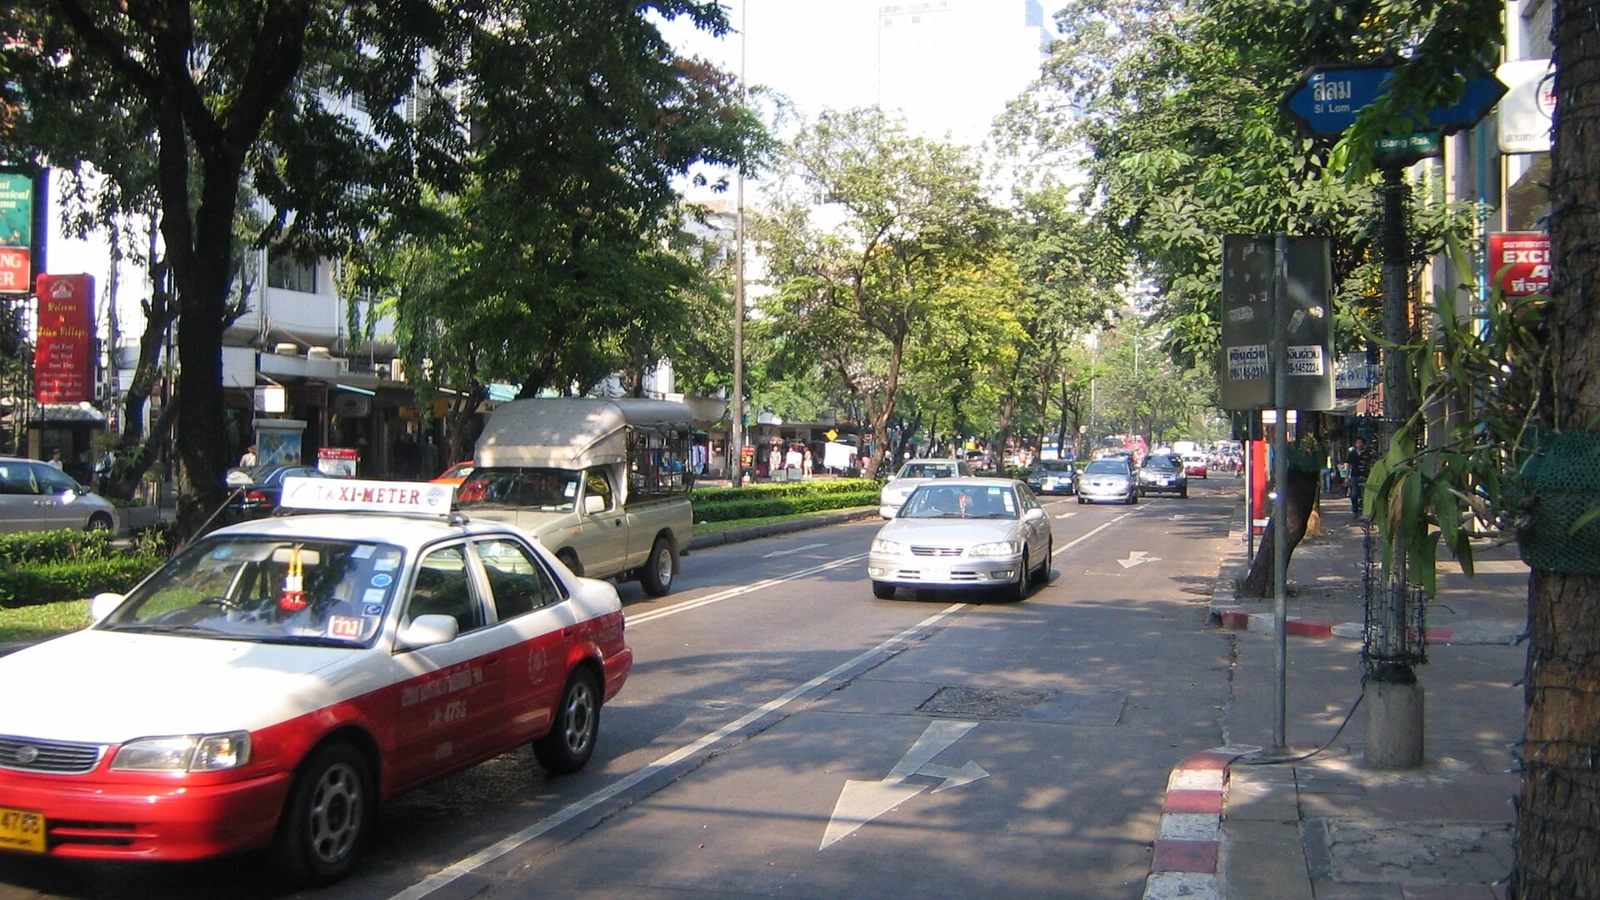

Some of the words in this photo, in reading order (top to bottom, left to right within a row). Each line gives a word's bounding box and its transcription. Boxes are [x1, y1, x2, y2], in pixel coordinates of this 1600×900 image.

[1313, 73, 1351, 100] สีลม
[1314, 105, 1324, 113] Si
[1328, 104, 1350, 113] Lom
[1381, 139, 1408, 148] Bang
[1410, 136, 1431, 146] Rak
[0, 190, 30, 200] ssical
[317, 485, 420, 505] TAXI-METER
